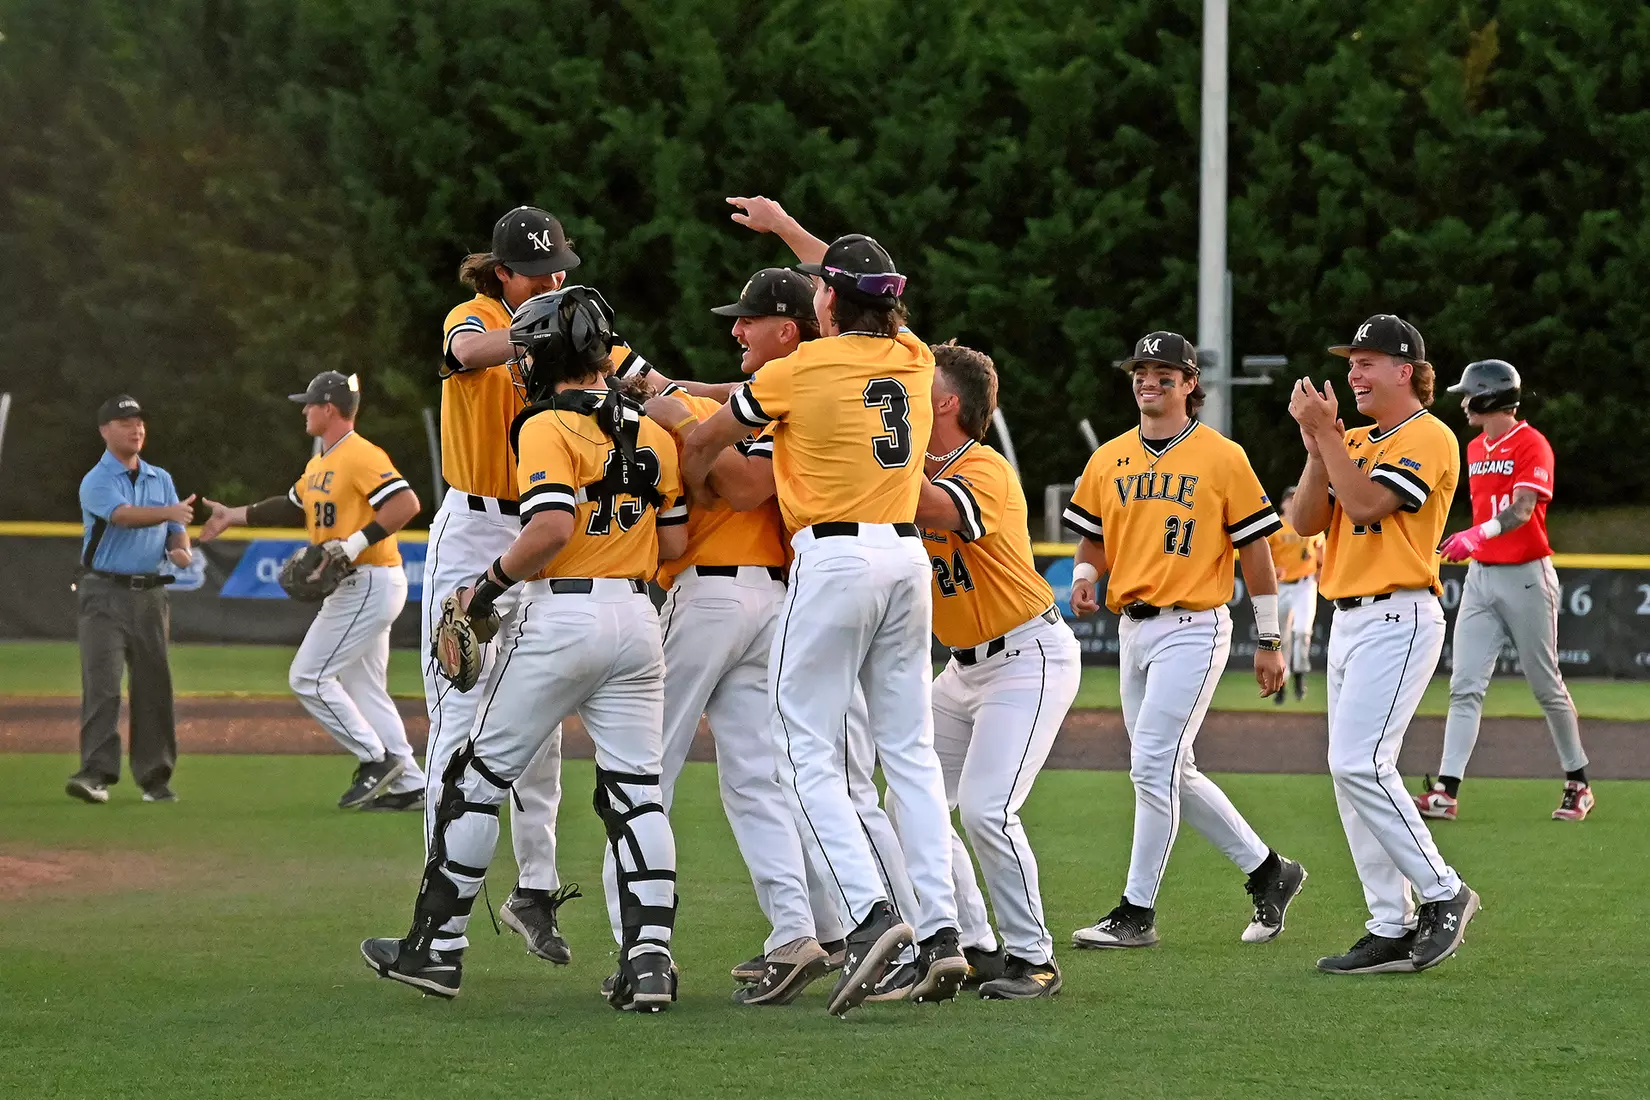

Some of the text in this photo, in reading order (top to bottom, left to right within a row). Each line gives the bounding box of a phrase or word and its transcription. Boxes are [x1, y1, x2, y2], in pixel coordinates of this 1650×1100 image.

[862, 376, 913, 469] 3
[1469, 460, 1515, 478] VULCANS
[1114, 471, 1199, 511] VILLE
[313, 501, 337, 529] 28
[1163, 515, 1197, 558] 21
[931, 548, 976, 598] 24
